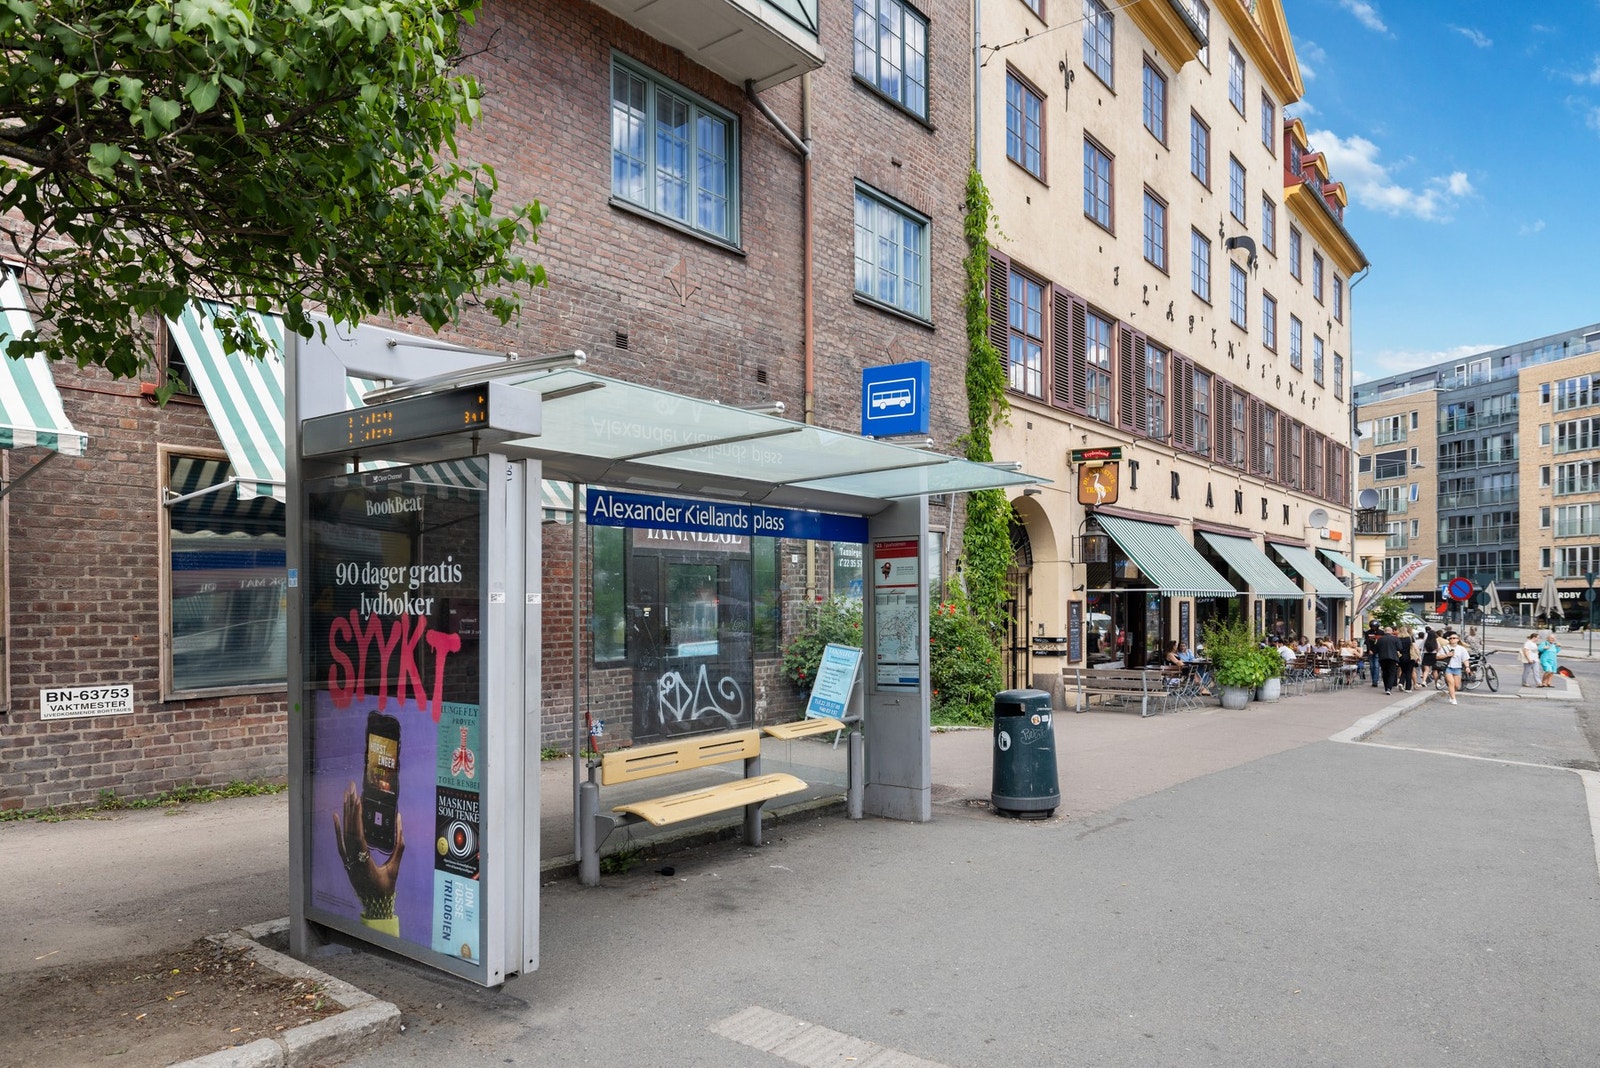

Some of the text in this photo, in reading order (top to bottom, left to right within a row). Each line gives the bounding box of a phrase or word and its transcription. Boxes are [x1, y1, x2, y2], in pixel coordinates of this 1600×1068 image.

[366, 496, 422, 516] BookBeat
[1128, 459, 1290, 526] TRANEN
[592, 496, 785, 534] Alexander Kiellands plass
[336, 556, 463, 590] 90 dager gratis
[360, 591, 434, 621] lydbøker
[328, 608, 462, 724] SYYKT
[46, 688, 130, 702] BN-63753
[50, 700, 126, 712] VAKTMESTER
[44, 710, 96, 718] UVEDKOMMENDE
[438, 776, 456, 786] TORE
[438, 806, 454, 818] SOM
[454, 881, 464, 920] FOSSE
[465, 884, 474, 908] JON
[442, 880, 452, 941] TRILOGIEN
